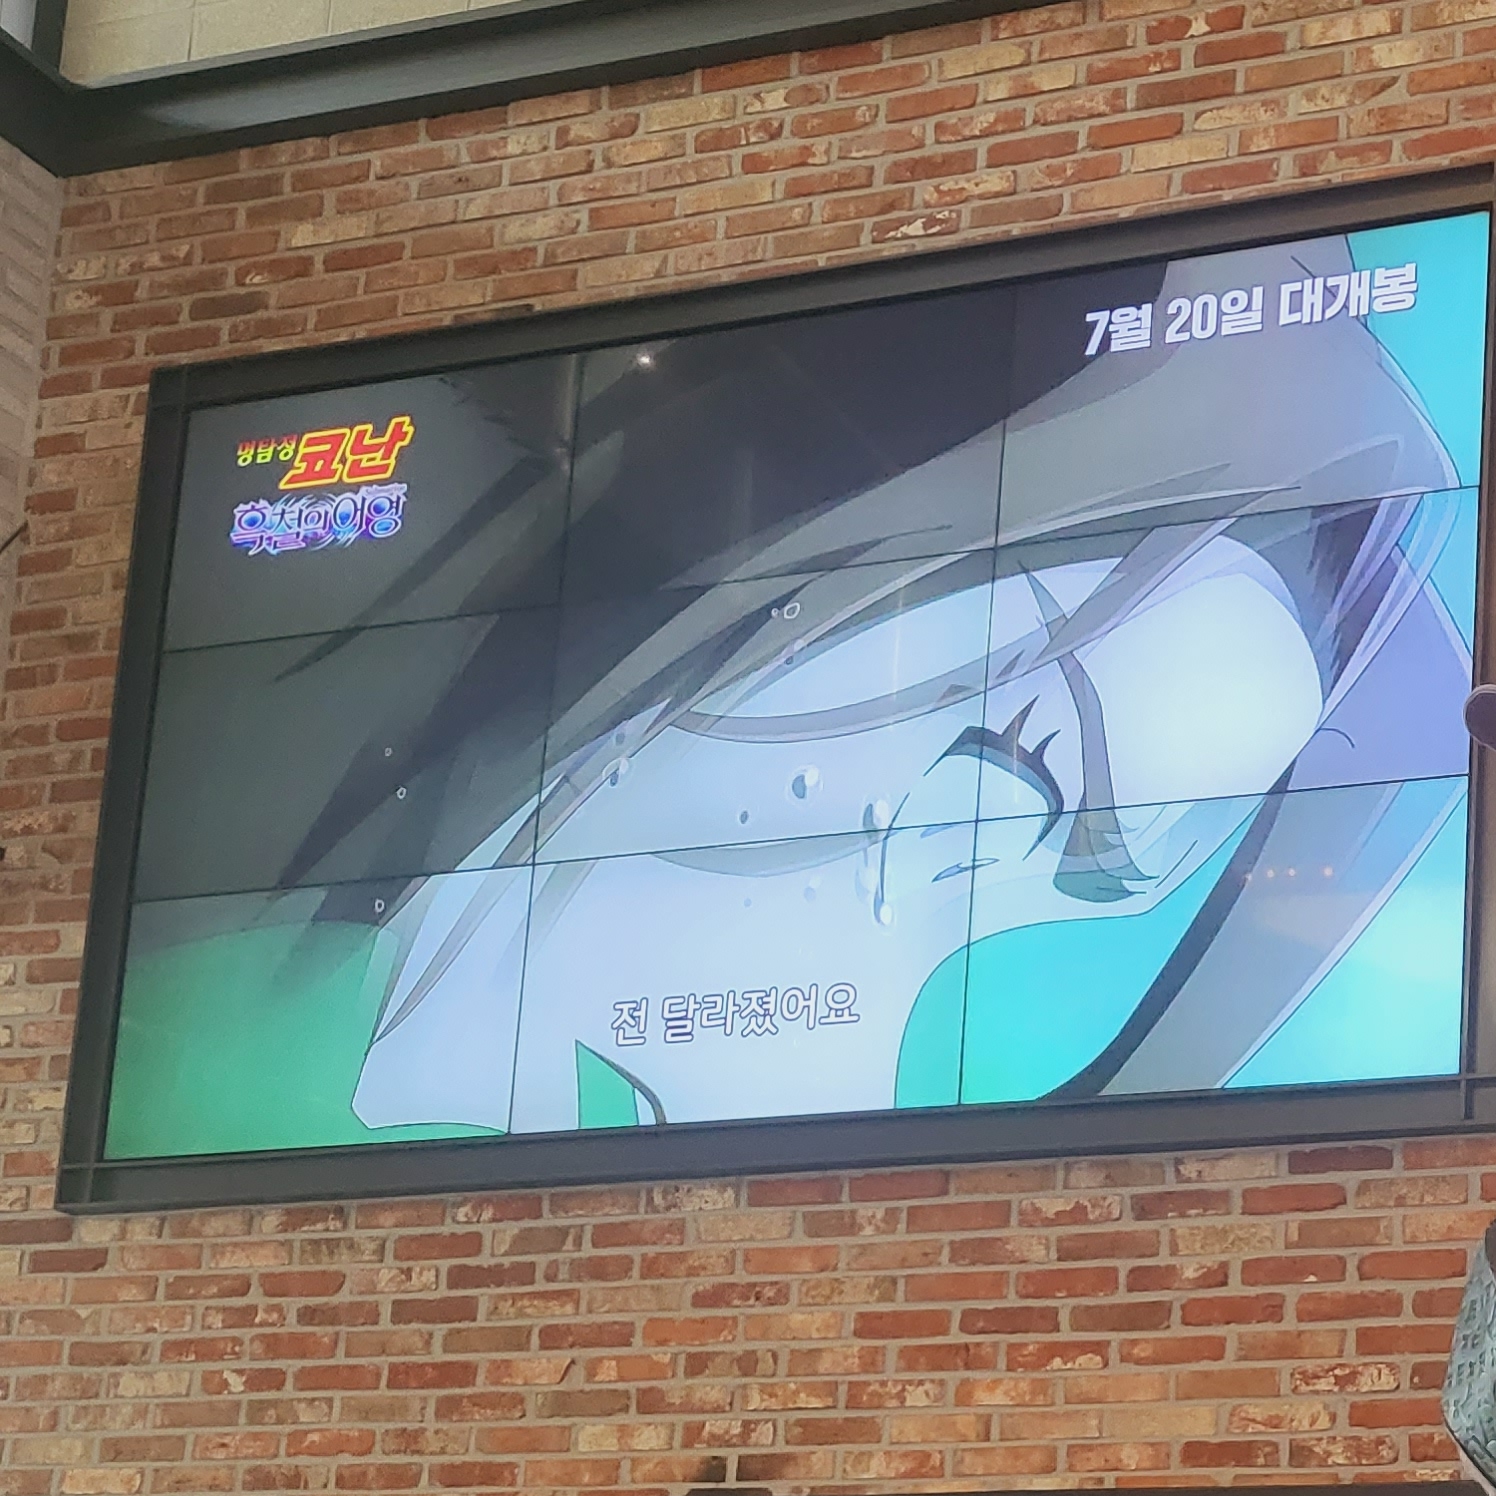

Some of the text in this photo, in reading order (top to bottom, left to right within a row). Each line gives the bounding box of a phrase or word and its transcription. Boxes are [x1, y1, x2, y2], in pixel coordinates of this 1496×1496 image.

[1085, 262, 1418, 356] 7월 20일 대개봉
[237, 415, 415, 490] 명탐정 코난
[611, 982, 860, 1046] 전 달라졌어요
